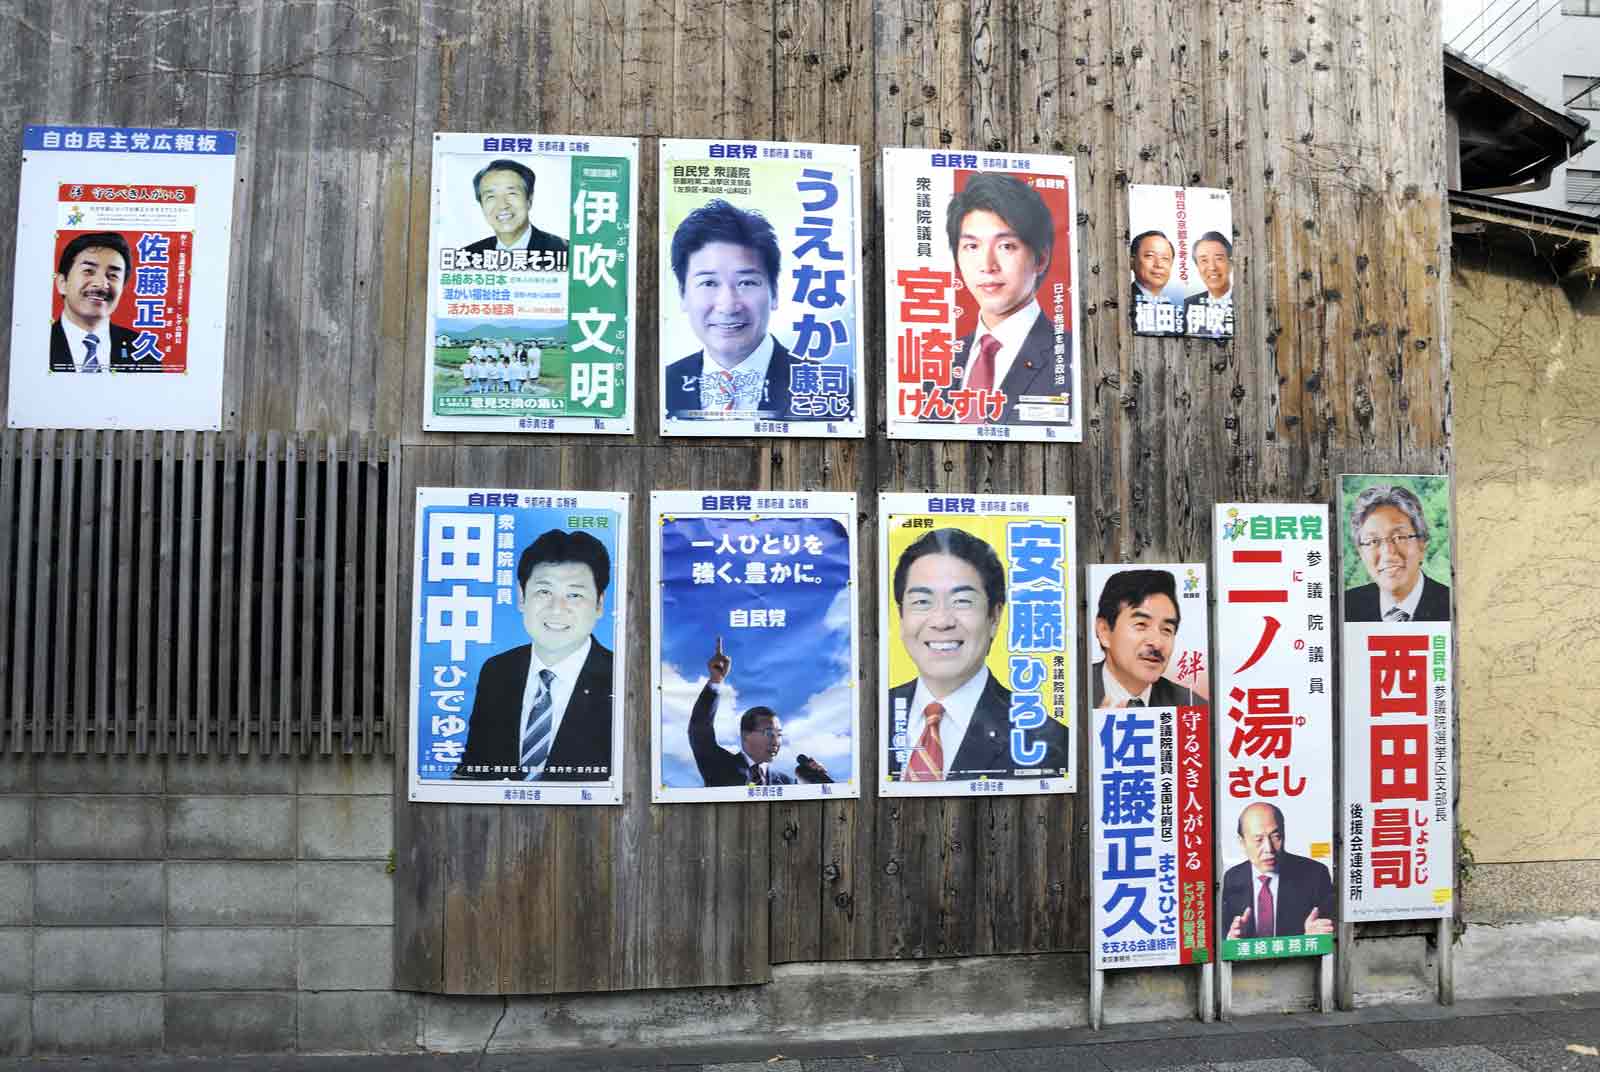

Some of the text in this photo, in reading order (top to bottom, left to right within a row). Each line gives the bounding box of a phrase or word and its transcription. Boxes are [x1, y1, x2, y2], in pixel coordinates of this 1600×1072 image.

[43, 131, 217, 153] 自由民主党広報板
[484, 138, 532, 152] 自民党
[709, 144, 757, 159] 自民党
[673, 166, 709, 178] 自民党
[931, 153, 978, 168] 自民党
[916, 177, 932, 257] 衆議院議員
[573, 188, 618, 289] 伊吹
[792, 168, 848, 360] うえなか
[132, 233, 169, 362] 佐藤正久
[897, 267, 952, 387] 宮崎
[571, 306, 617, 410] 文明
[791, 364, 848, 396] 康司
[791, 397, 848, 416] こうじ
[898, 389, 1007, 421] けんすけ
[468, 493, 518, 508] 自民党
[702, 495, 752, 511] 自民党
[928, 498, 975, 513] 自民党
[567, 515, 609, 528] 自民党
[1250, 515, 1322, 540] 自民党
[691, 533, 823, 555] 一人ひとりを
[692, 562, 823, 584] 強く、豊かに。
[729, 608, 787, 628] 自民党
[1307, 551, 1324, 694] 参議院議員
[1178, 651, 1204, 684] 絆
[1433, 635, 1446, 682] 自民党
[1183, 711, 1203, 870] 守るべき人がいる
[1228, 766, 1306, 798] さとし
[1100, 713, 1157, 938] 佐藤正久
[1350, 802, 1363, 901] 後援会連絡所
[1414, 808, 1429, 885] しょうじ
[1159, 854, 1177, 935] まさひさ
[1102, 938, 1177, 953] を支える会連絡所
[1238, 938, 1318, 955] 連絡事務所
